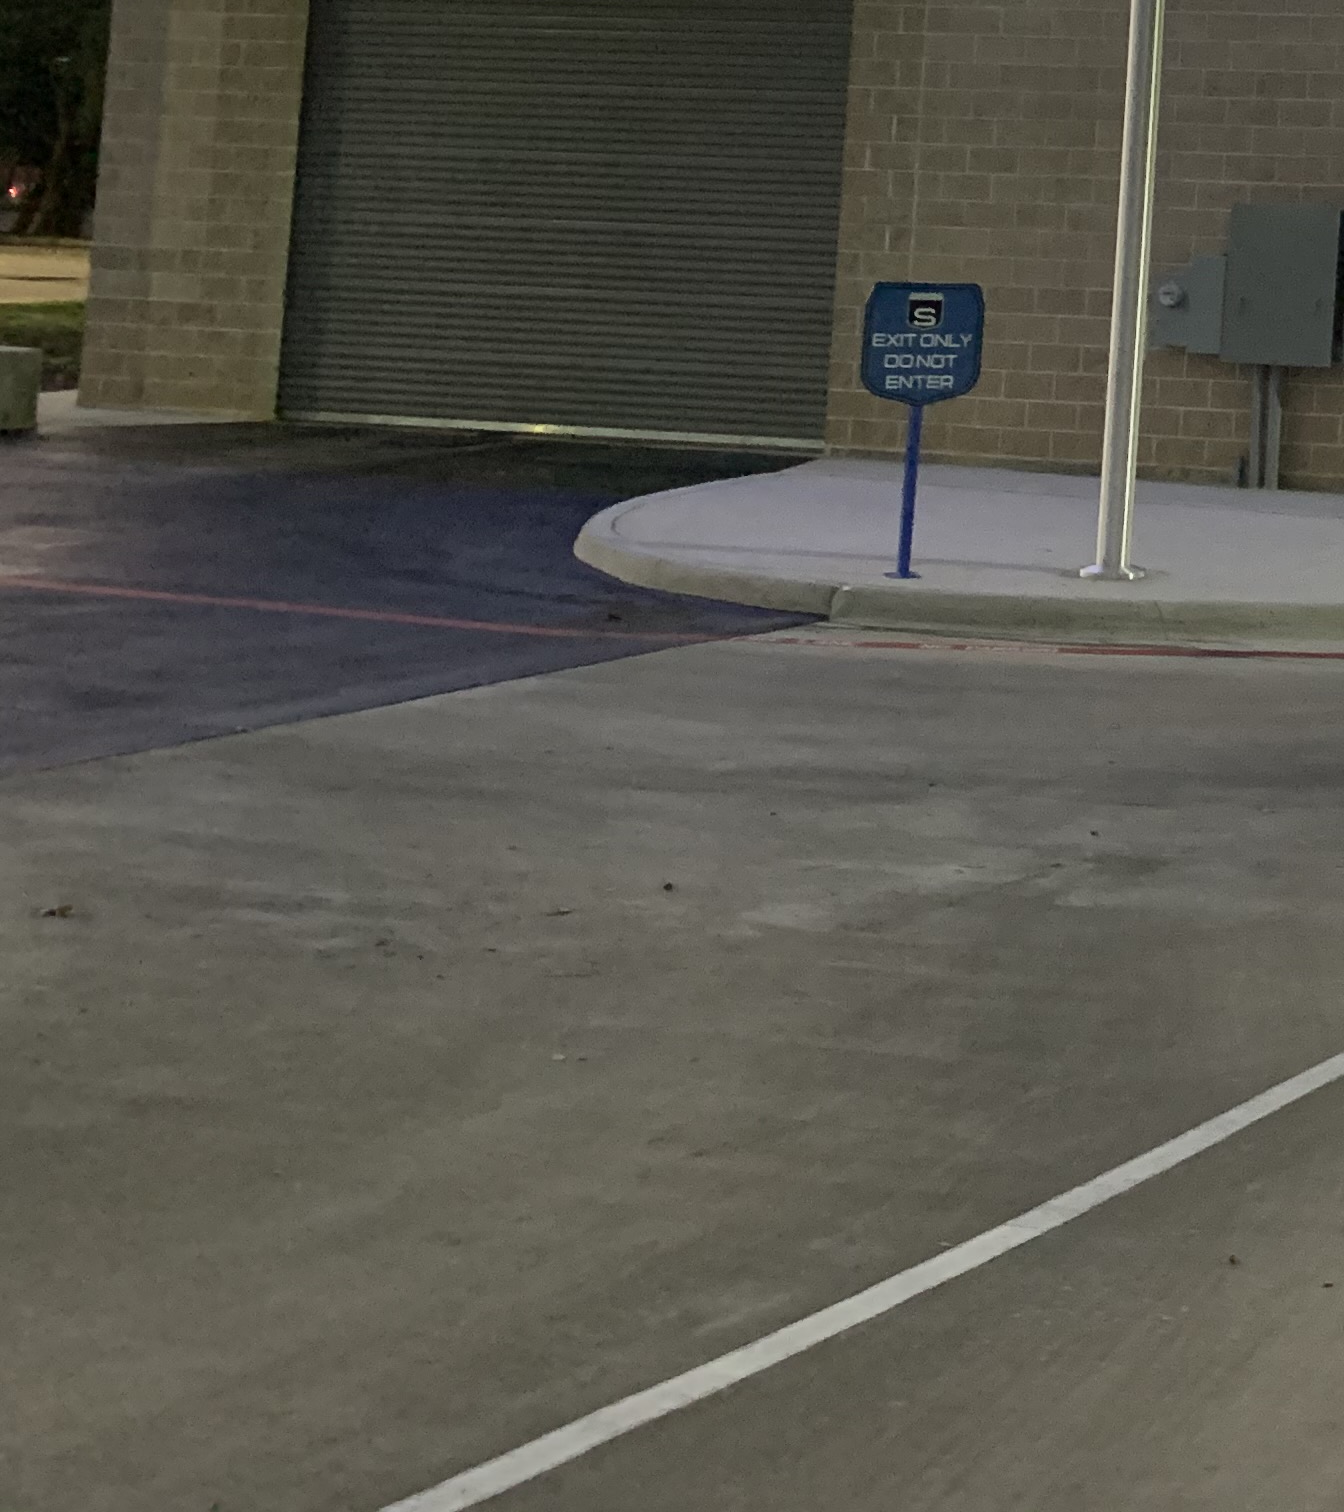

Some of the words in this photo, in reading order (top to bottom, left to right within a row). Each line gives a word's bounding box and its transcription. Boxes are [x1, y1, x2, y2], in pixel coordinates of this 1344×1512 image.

[913, 307, 937, 327] S
[872, 333, 917, 347] EXIT
[920, 333, 973, 347] ONLY
[884, 354, 914, 368] DO
[916, 354, 958, 368] NOT
[885, 375, 954, 389] ENTER
